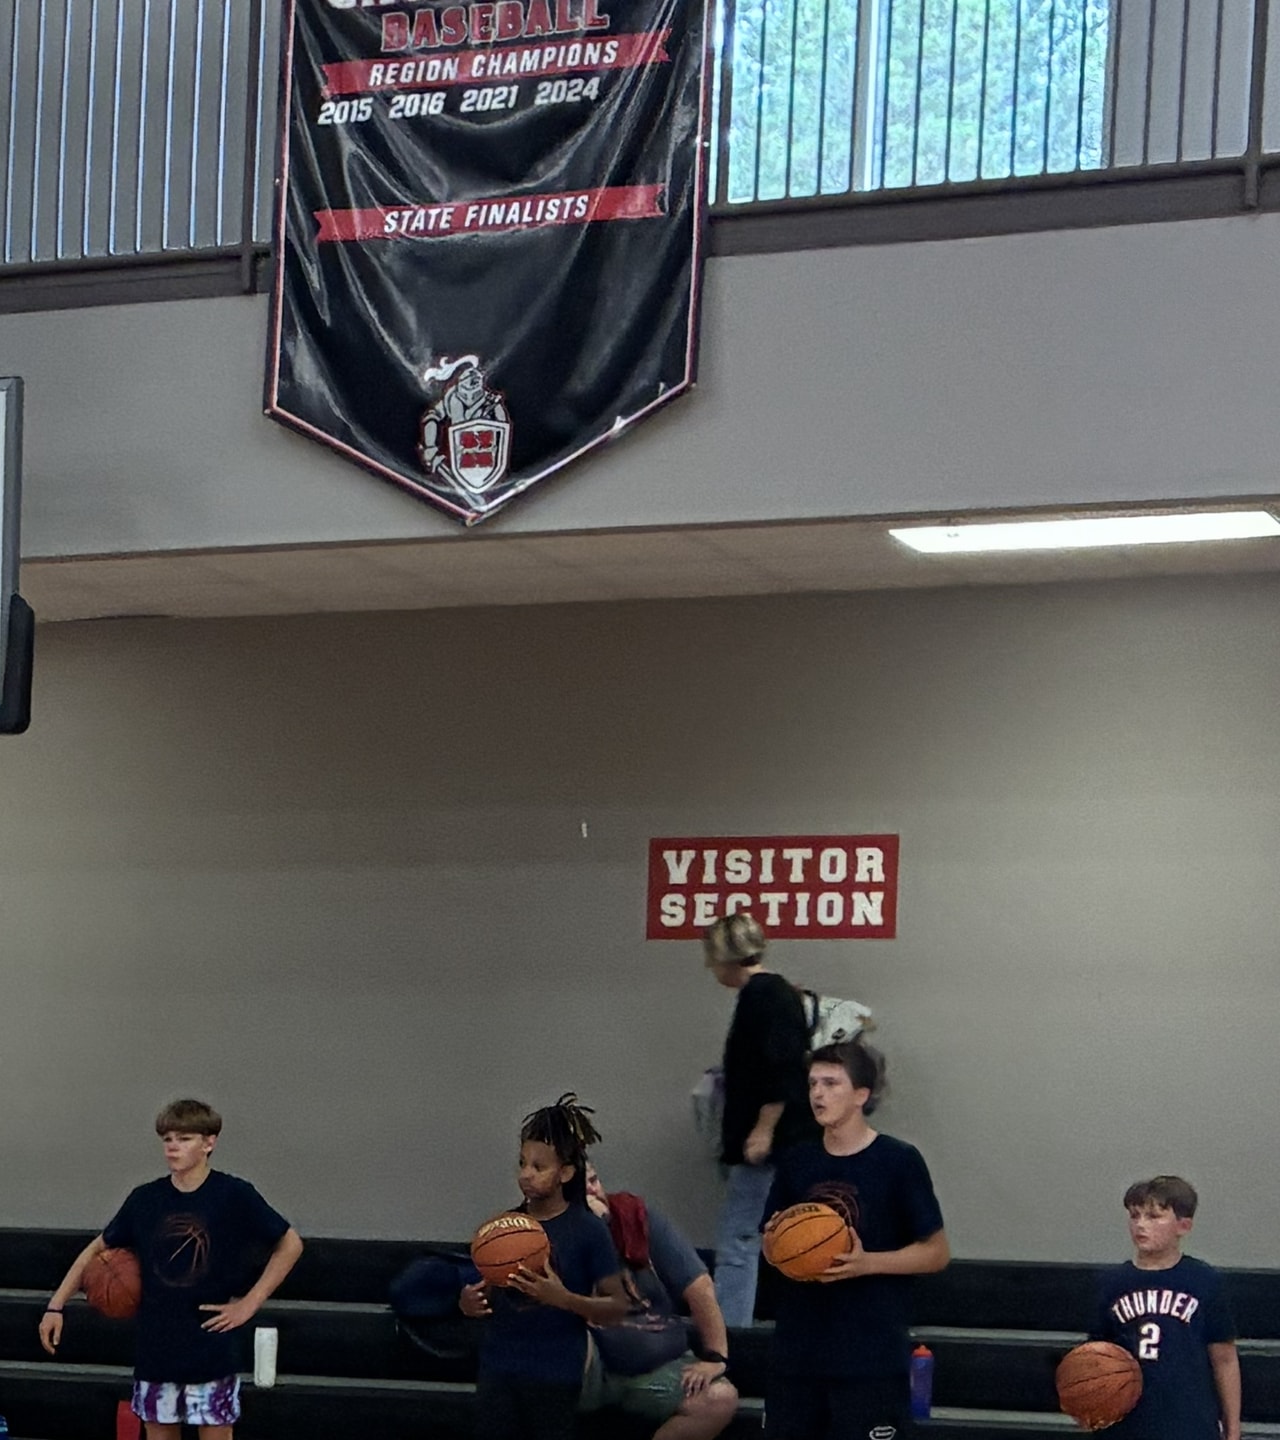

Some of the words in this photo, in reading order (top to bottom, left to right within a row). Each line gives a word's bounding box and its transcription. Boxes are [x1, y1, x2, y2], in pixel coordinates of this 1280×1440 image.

[380, 0, 610, 52] BASEBALL
[368, 57, 459, 87] REGION
[470, 40, 619, 78] CHAMPIONS
[317, 98, 373, 125] 2015
[388, 91, 446, 119] 2016
[461, 84, 519, 113] 2021
[534, 76, 600, 106] 2024
[384, 209, 453, 233] STATE
[464, 194, 590, 227] FINALISTS
[663, 847, 885, 885] VISITOR
[660, 892, 884, 927] SECTION
[1111, 1289, 1199, 1324] THUNDER
[1139, 1322, 1161, 1361] 2
